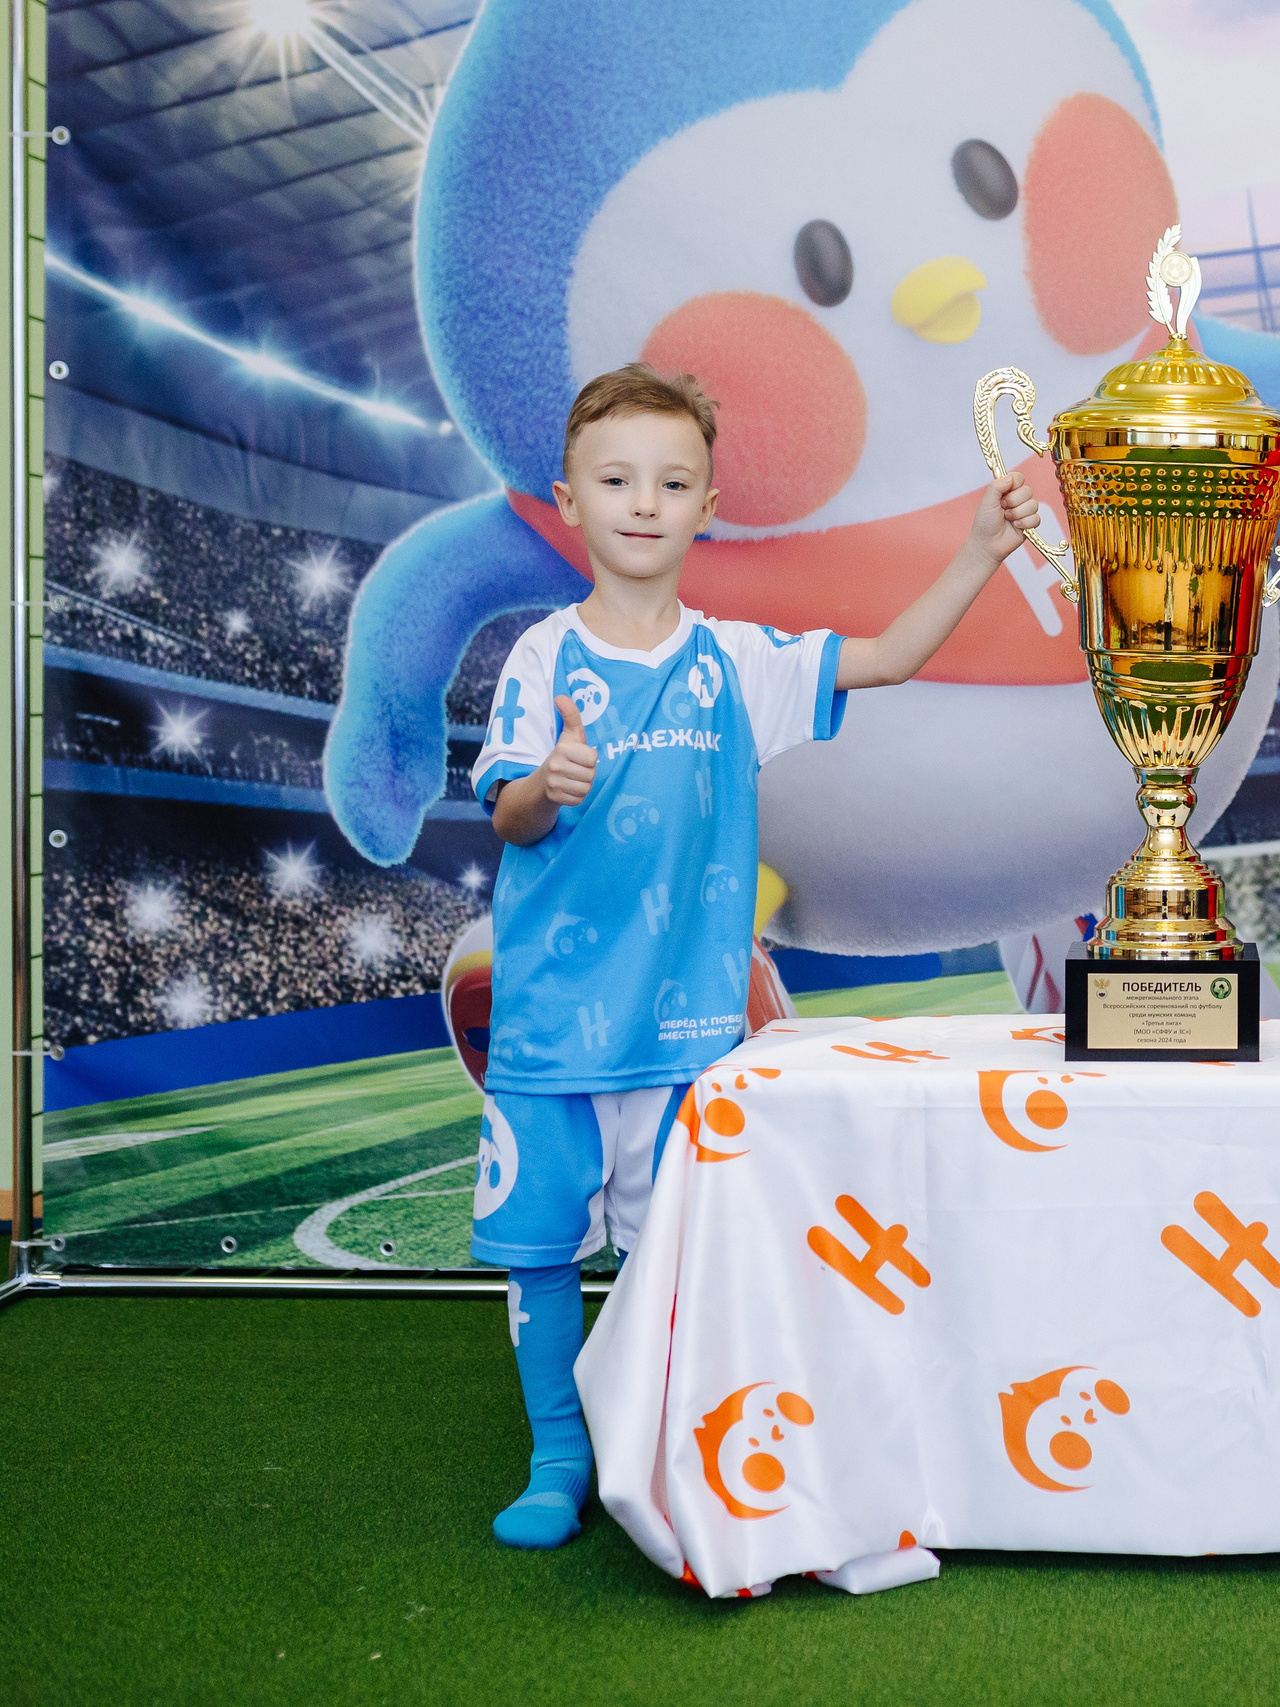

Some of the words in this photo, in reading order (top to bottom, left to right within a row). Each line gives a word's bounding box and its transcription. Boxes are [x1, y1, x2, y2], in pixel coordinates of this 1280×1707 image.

[1122, 982, 1202, 994] ПОБЕДИТЕЛЬ
[660, 1018, 698, 1030] ВПЕРЁД
[700, 1018, 708, 1027] К
[658, 1030, 699, 1041] ВМЕСТЕ
[701, 1027, 722, 1038] МЫ
